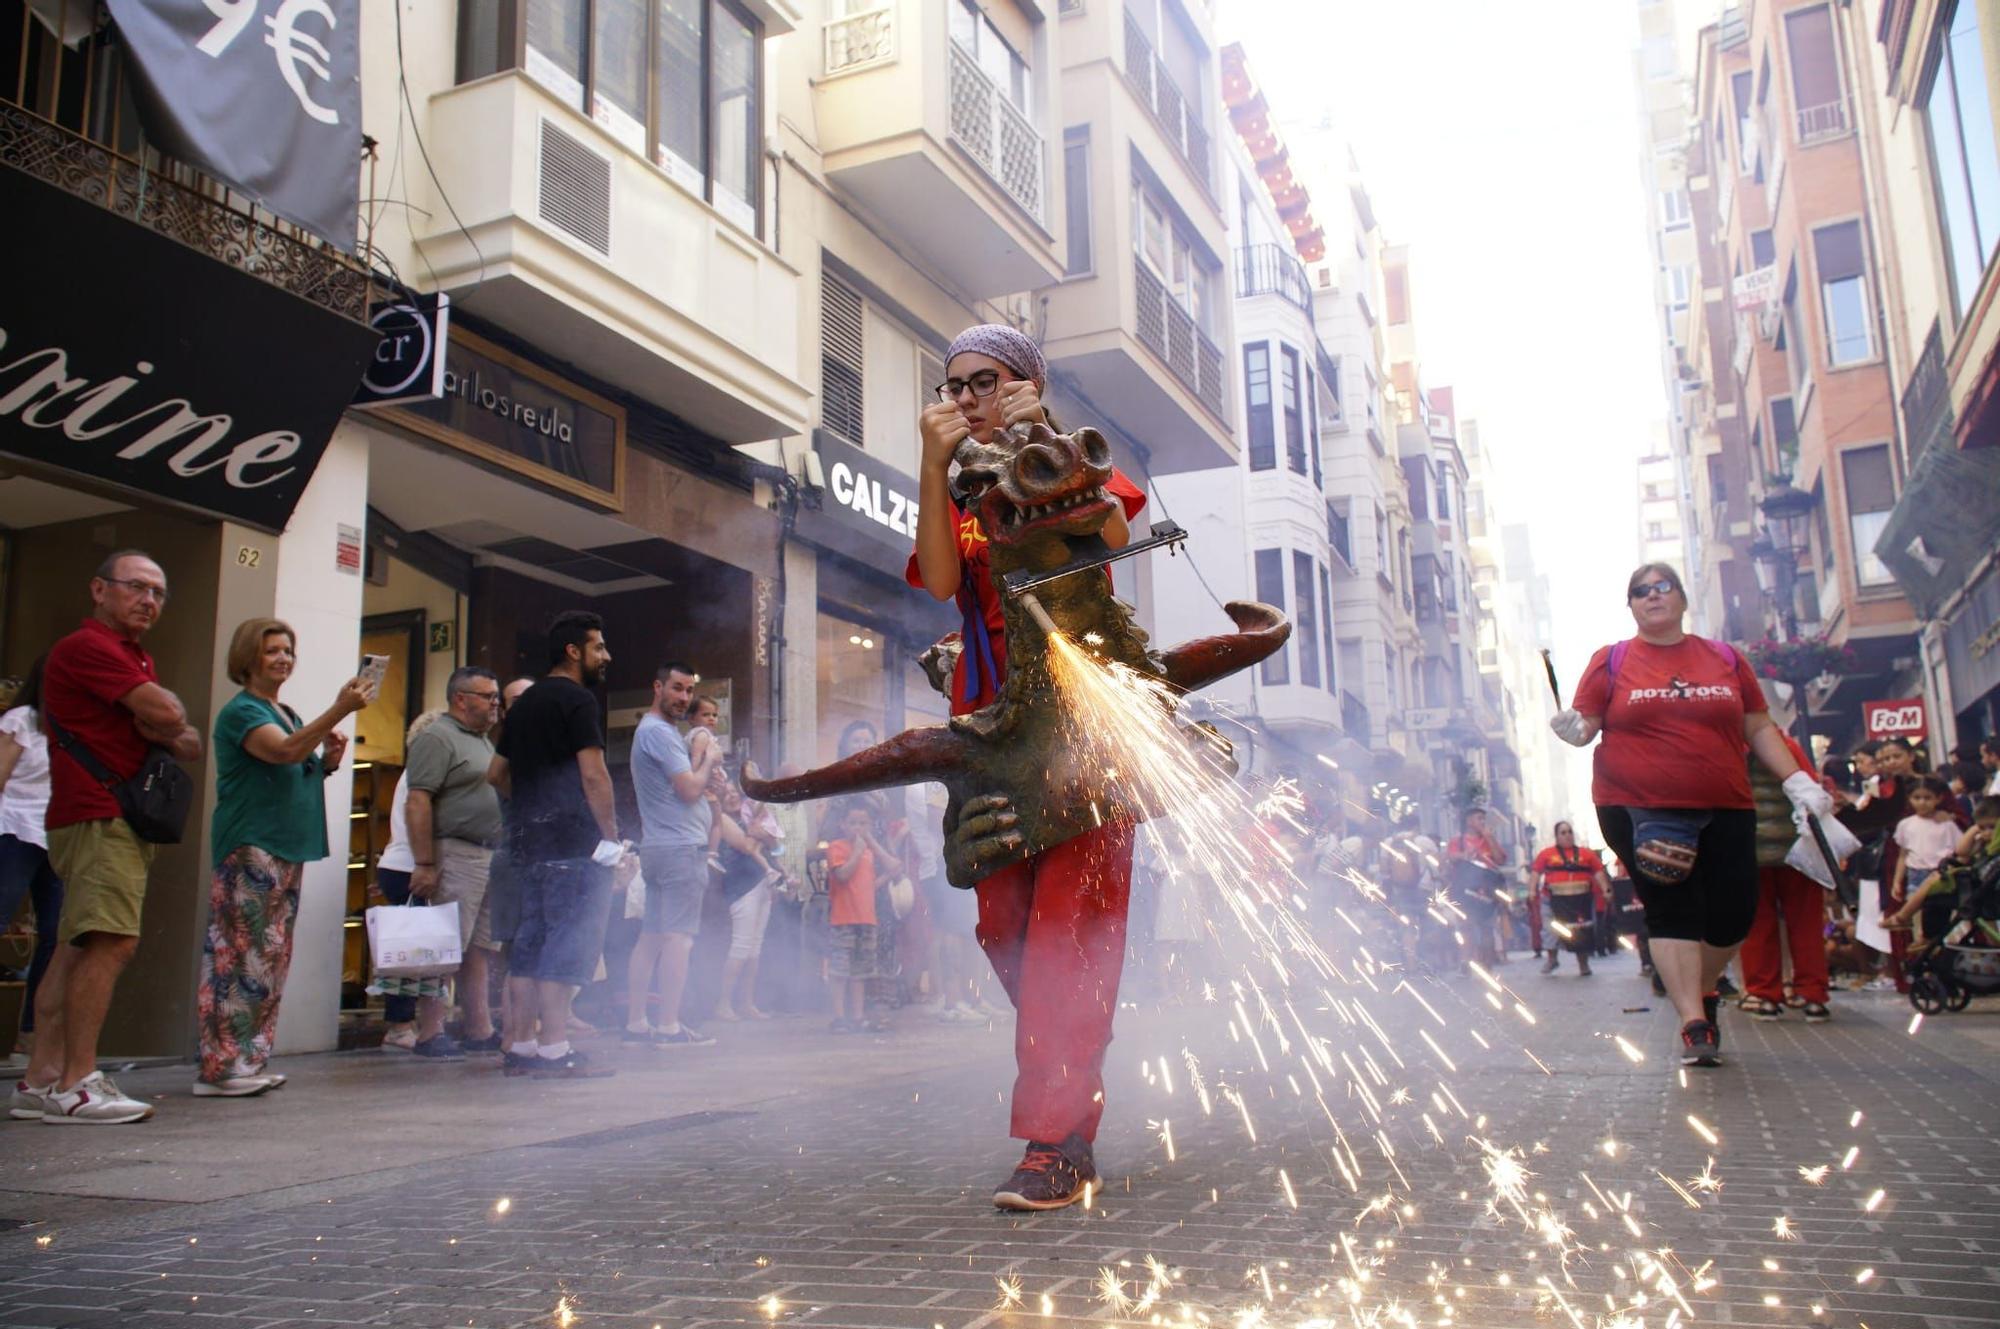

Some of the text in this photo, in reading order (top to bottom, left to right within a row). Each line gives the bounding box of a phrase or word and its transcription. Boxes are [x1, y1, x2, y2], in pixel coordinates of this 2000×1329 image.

[376, 334, 410, 362] cr
[0, 346, 300, 488] rine
[443, 369, 571, 443] arlos reula
[832, 462, 919, 540] CALZE
[237, 547, 259, 567] 62
